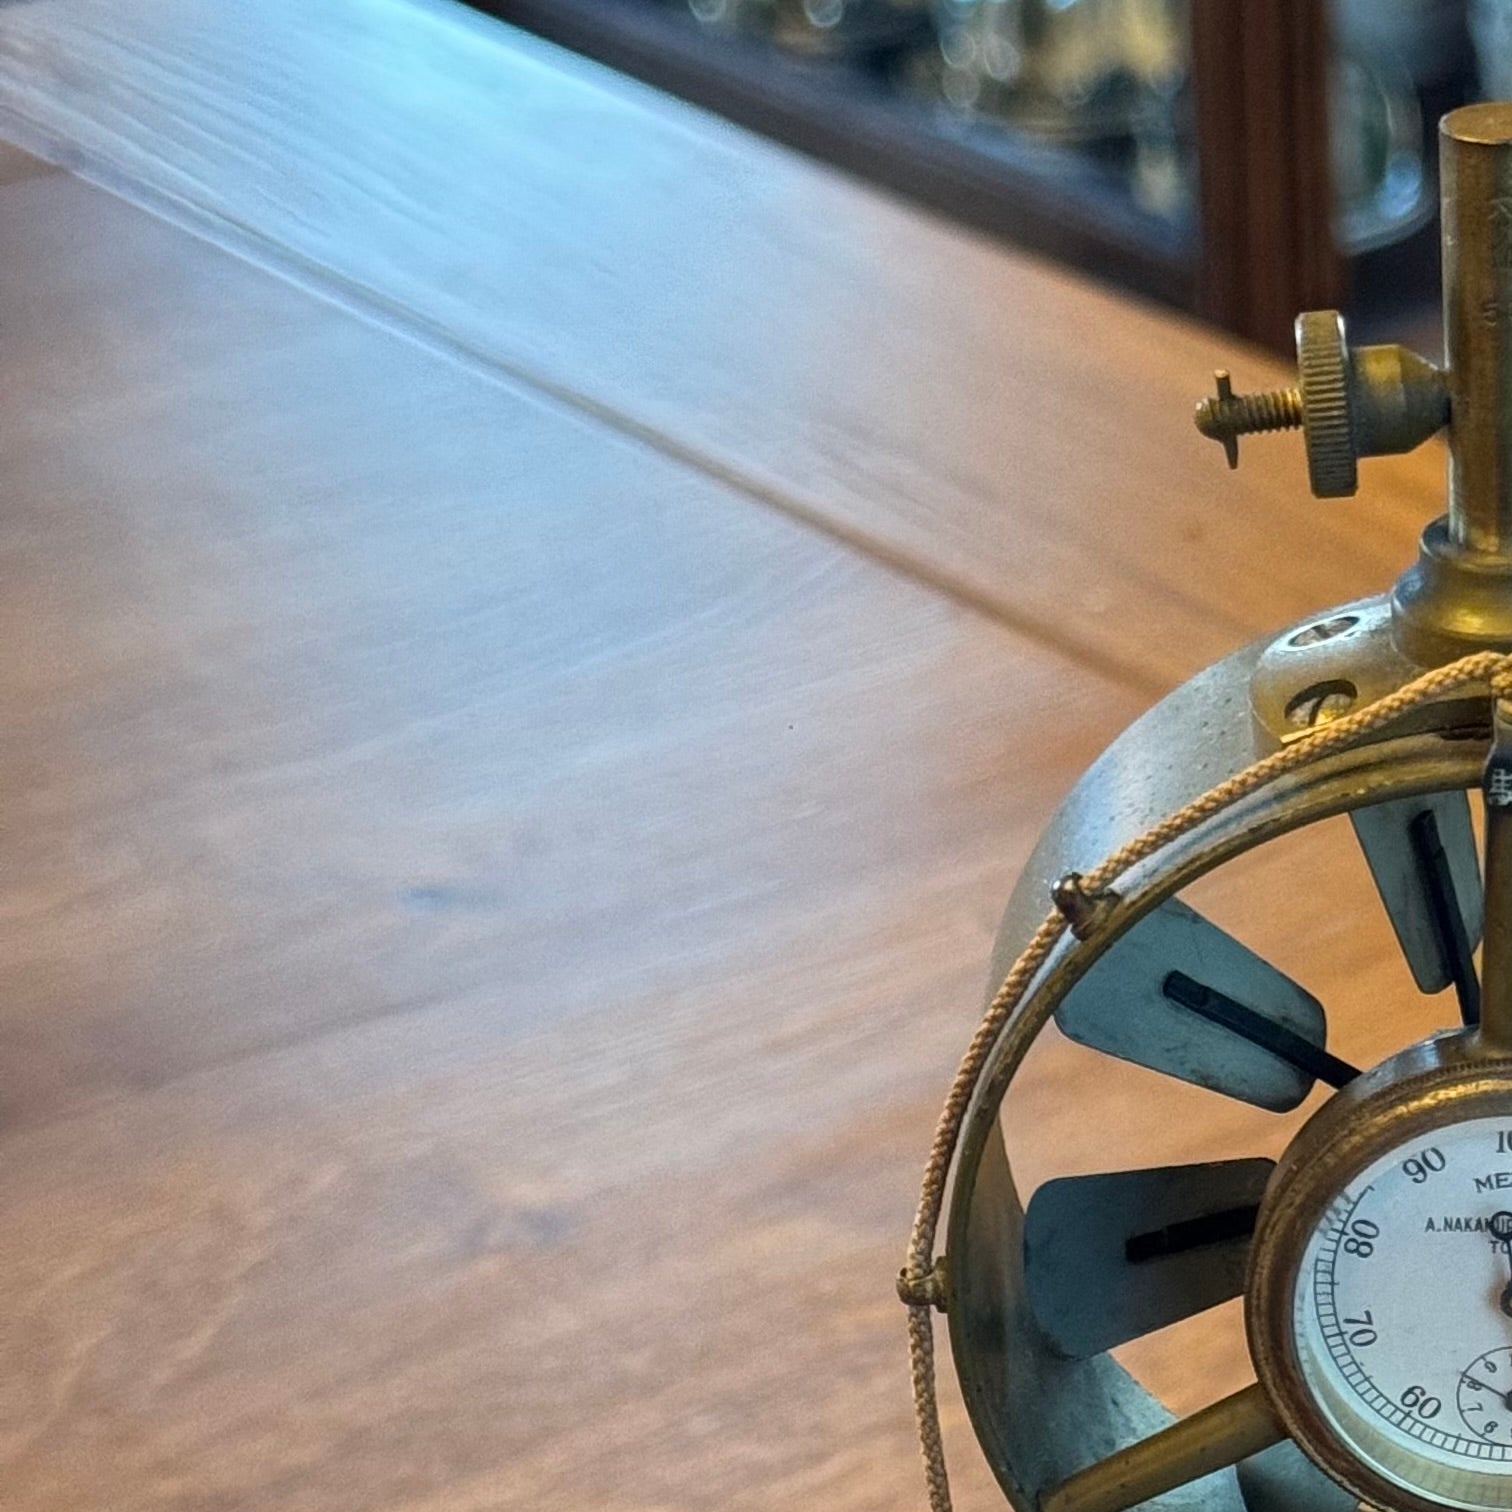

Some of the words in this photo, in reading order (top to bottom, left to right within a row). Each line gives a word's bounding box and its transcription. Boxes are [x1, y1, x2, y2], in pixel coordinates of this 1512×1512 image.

[1402, 1147, 1446, 1184] 90
[1344, 1219, 1380, 1258] 80
[1343, 1311, 1378, 1347] 70
[1484, 1361, 1497, 1373] 9
[1466, 1380, 1482, 1392] 8
[1399, 1385, 1442, 1420] 60
[1467, 1402, 1484, 1412] 7
[1483, 1421, 1498, 1433] 6
